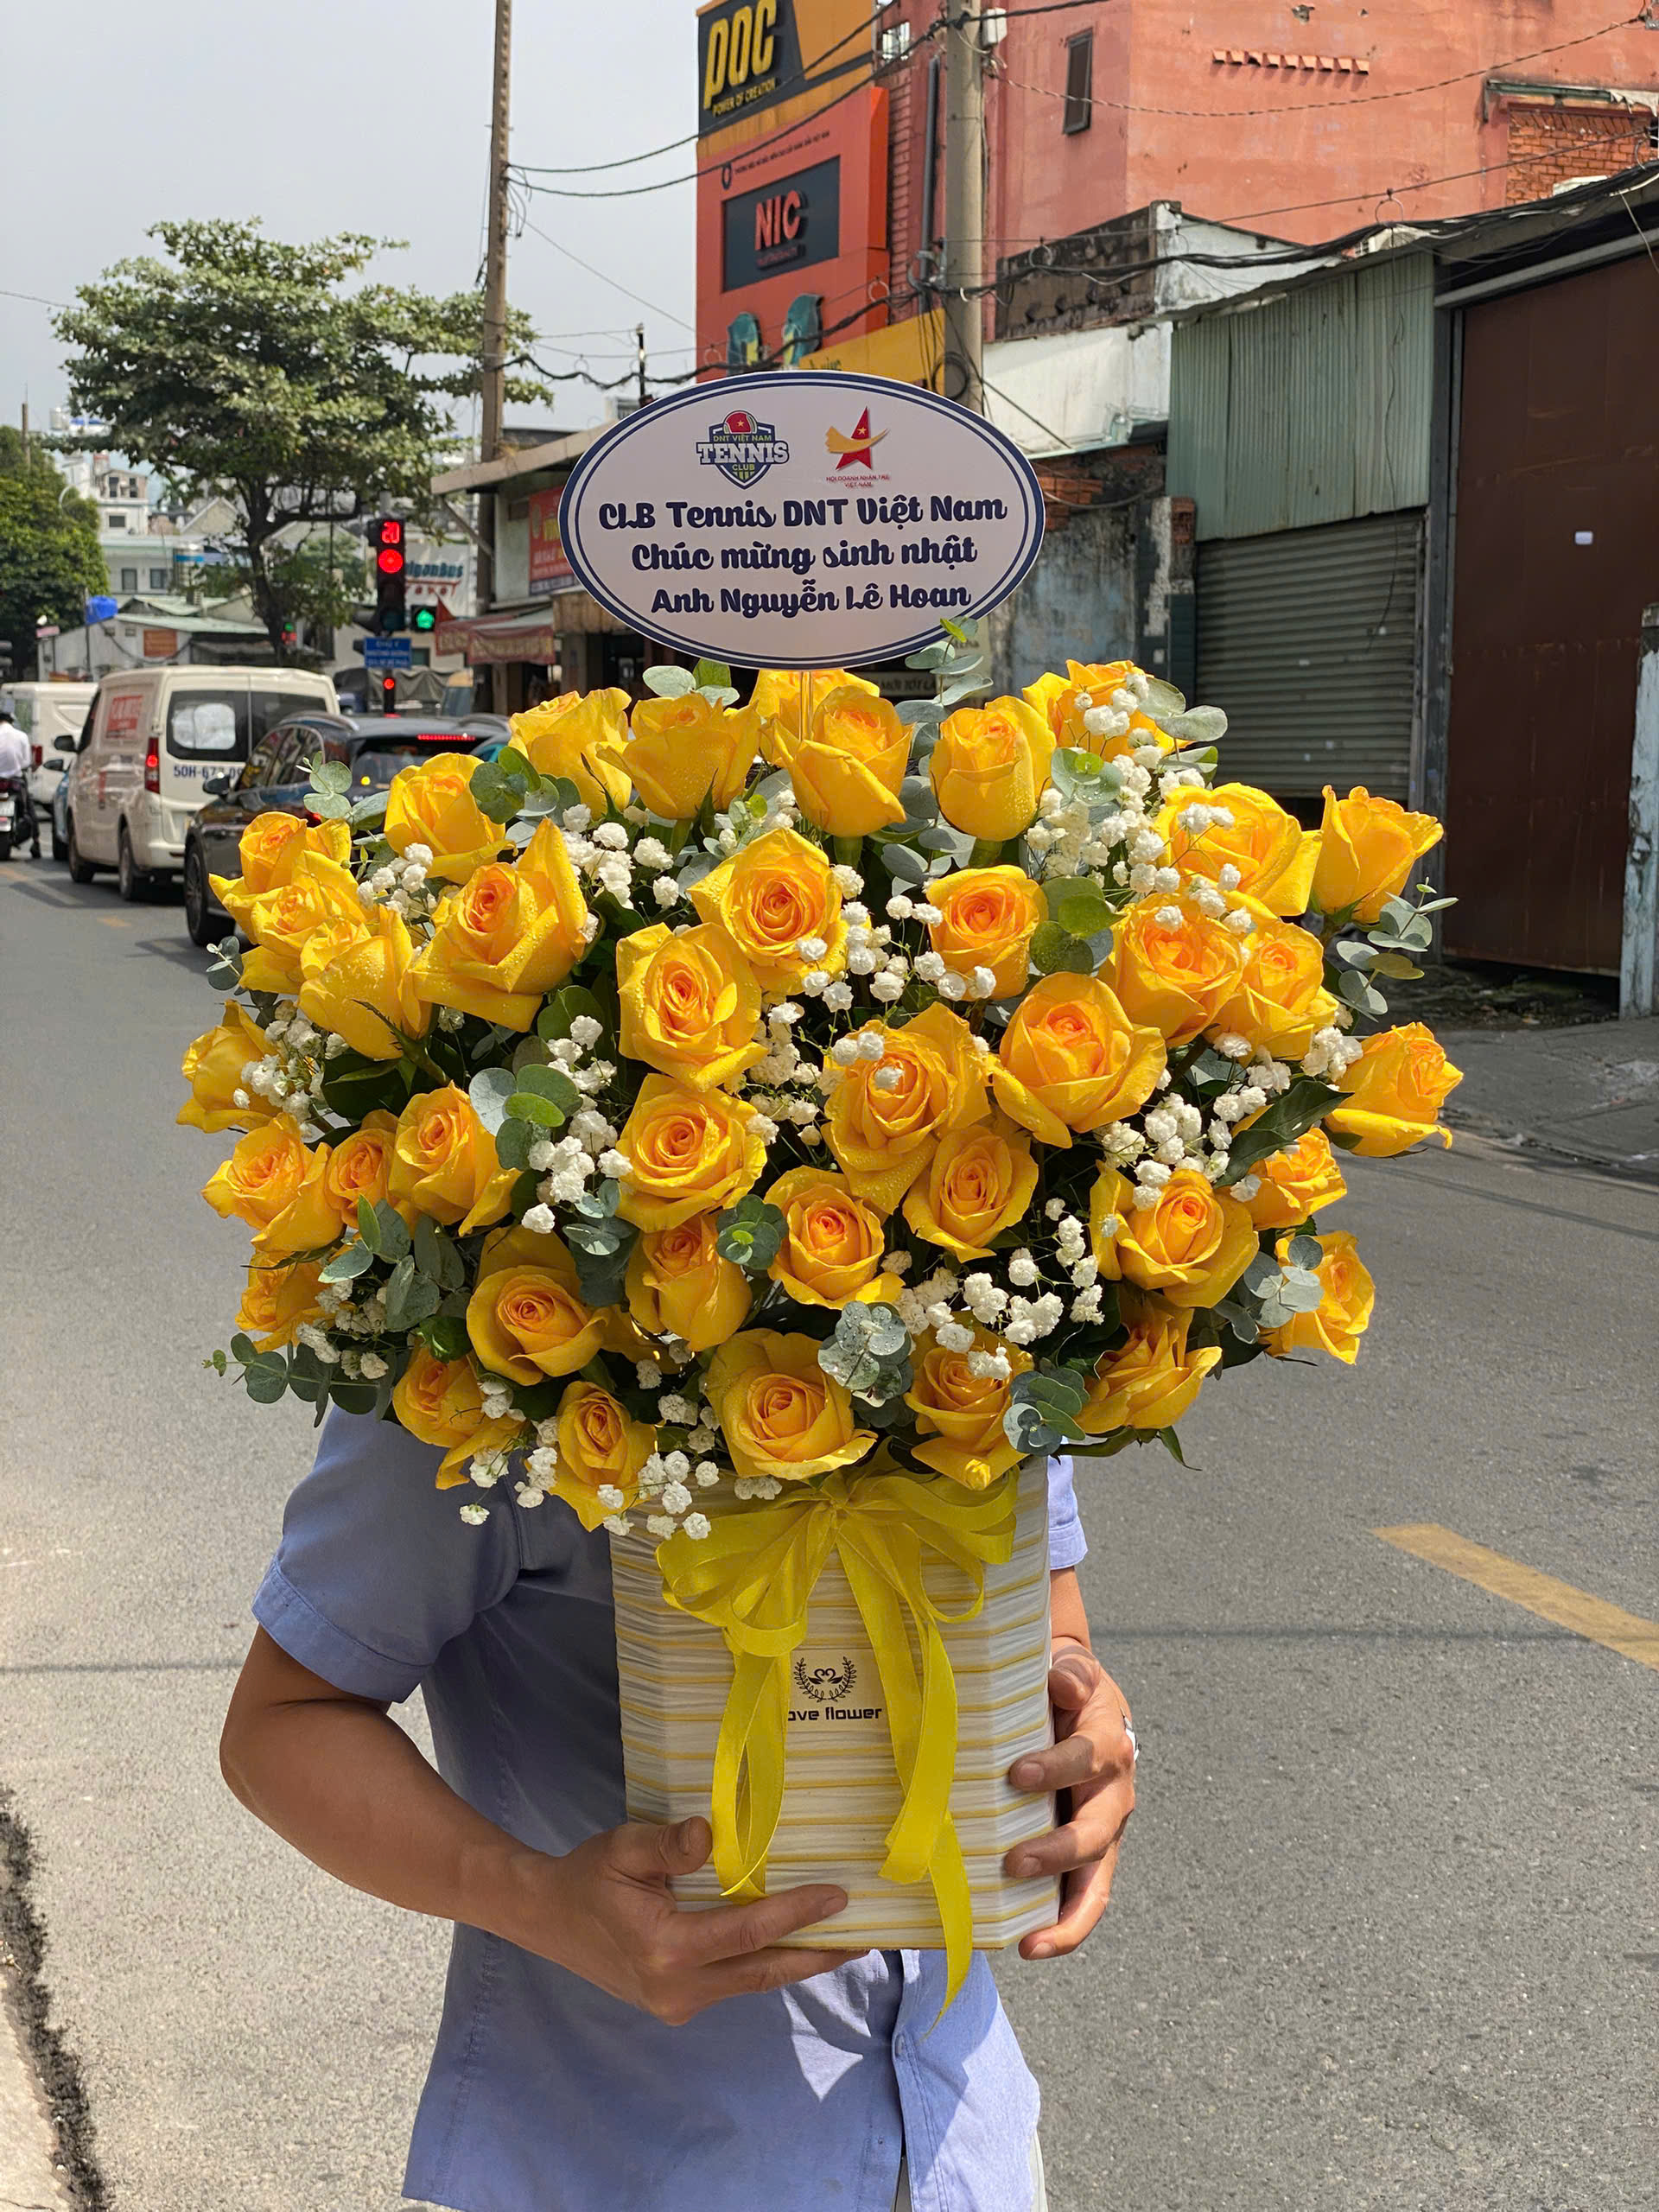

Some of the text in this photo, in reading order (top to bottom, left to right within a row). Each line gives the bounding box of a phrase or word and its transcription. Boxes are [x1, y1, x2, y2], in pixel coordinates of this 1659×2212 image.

[703, 0, 778, 111] POC
[754, 190, 801, 251] NIC
[696, 441, 789, 464] TENNIS
[599, 494, 1008, 531] CLB Tennis DNT Việt Nam
[632, 535, 978, 575] Chúc mừng sinh nhật
[651, 579, 971, 619] Anh Nguyễn Lê Hoan
[788, 1707, 882, 1721] ove flower
